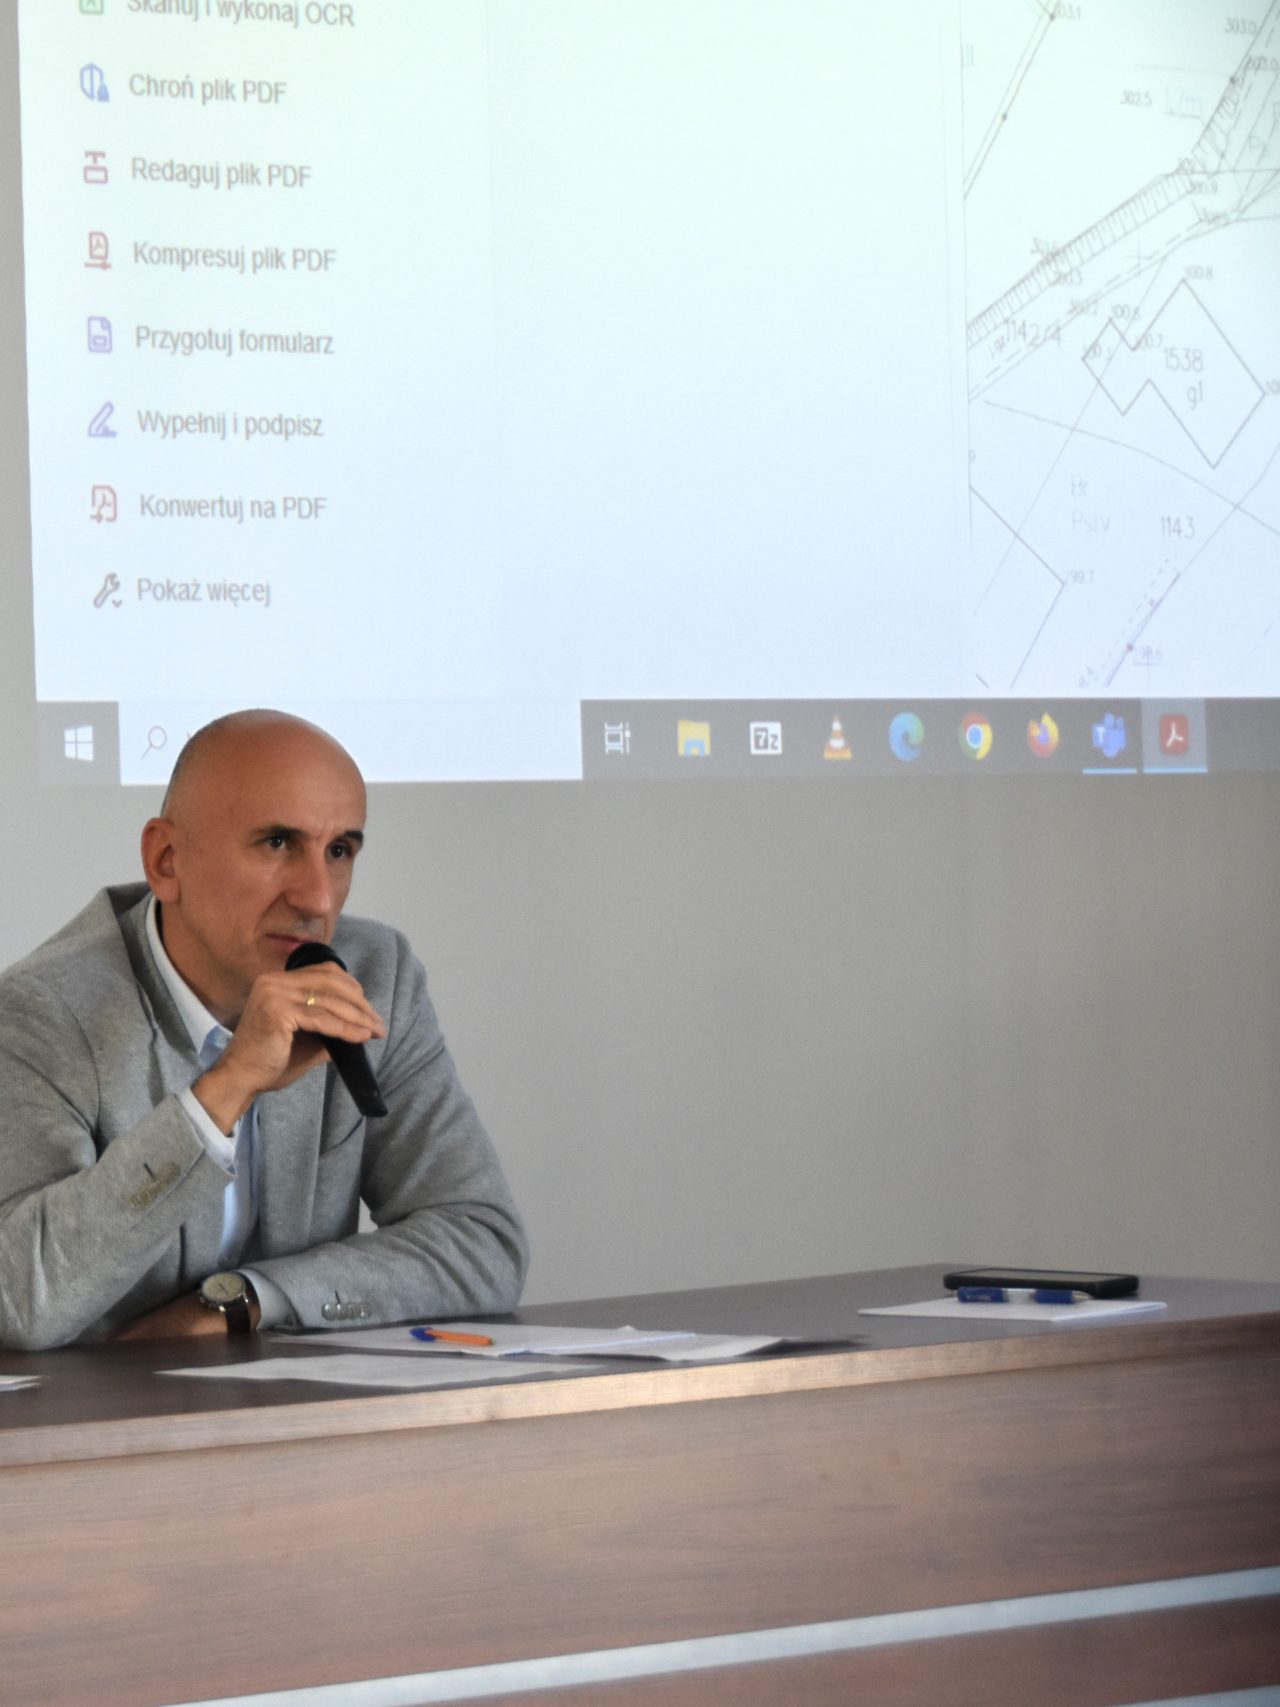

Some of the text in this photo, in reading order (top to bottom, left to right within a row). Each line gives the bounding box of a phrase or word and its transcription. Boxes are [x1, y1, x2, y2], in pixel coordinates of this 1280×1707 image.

[218, 0, 300, 28] wykonaj
[305, 2, 355, 27] OCR
[128, 73, 287, 105] Chroń plik PDF
[131, 157, 312, 190] Redaguj plik PDF
[133, 241, 337, 275] Kompresuj plik PDF
[135, 325, 335, 357] Przygotuj formularz
[137, 409, 324, 441] Wypełnij i podpisz
[140, 494, 326, 524] Konwertuj na PDF
[137, 577, 272, 607] Pokaż więcej
